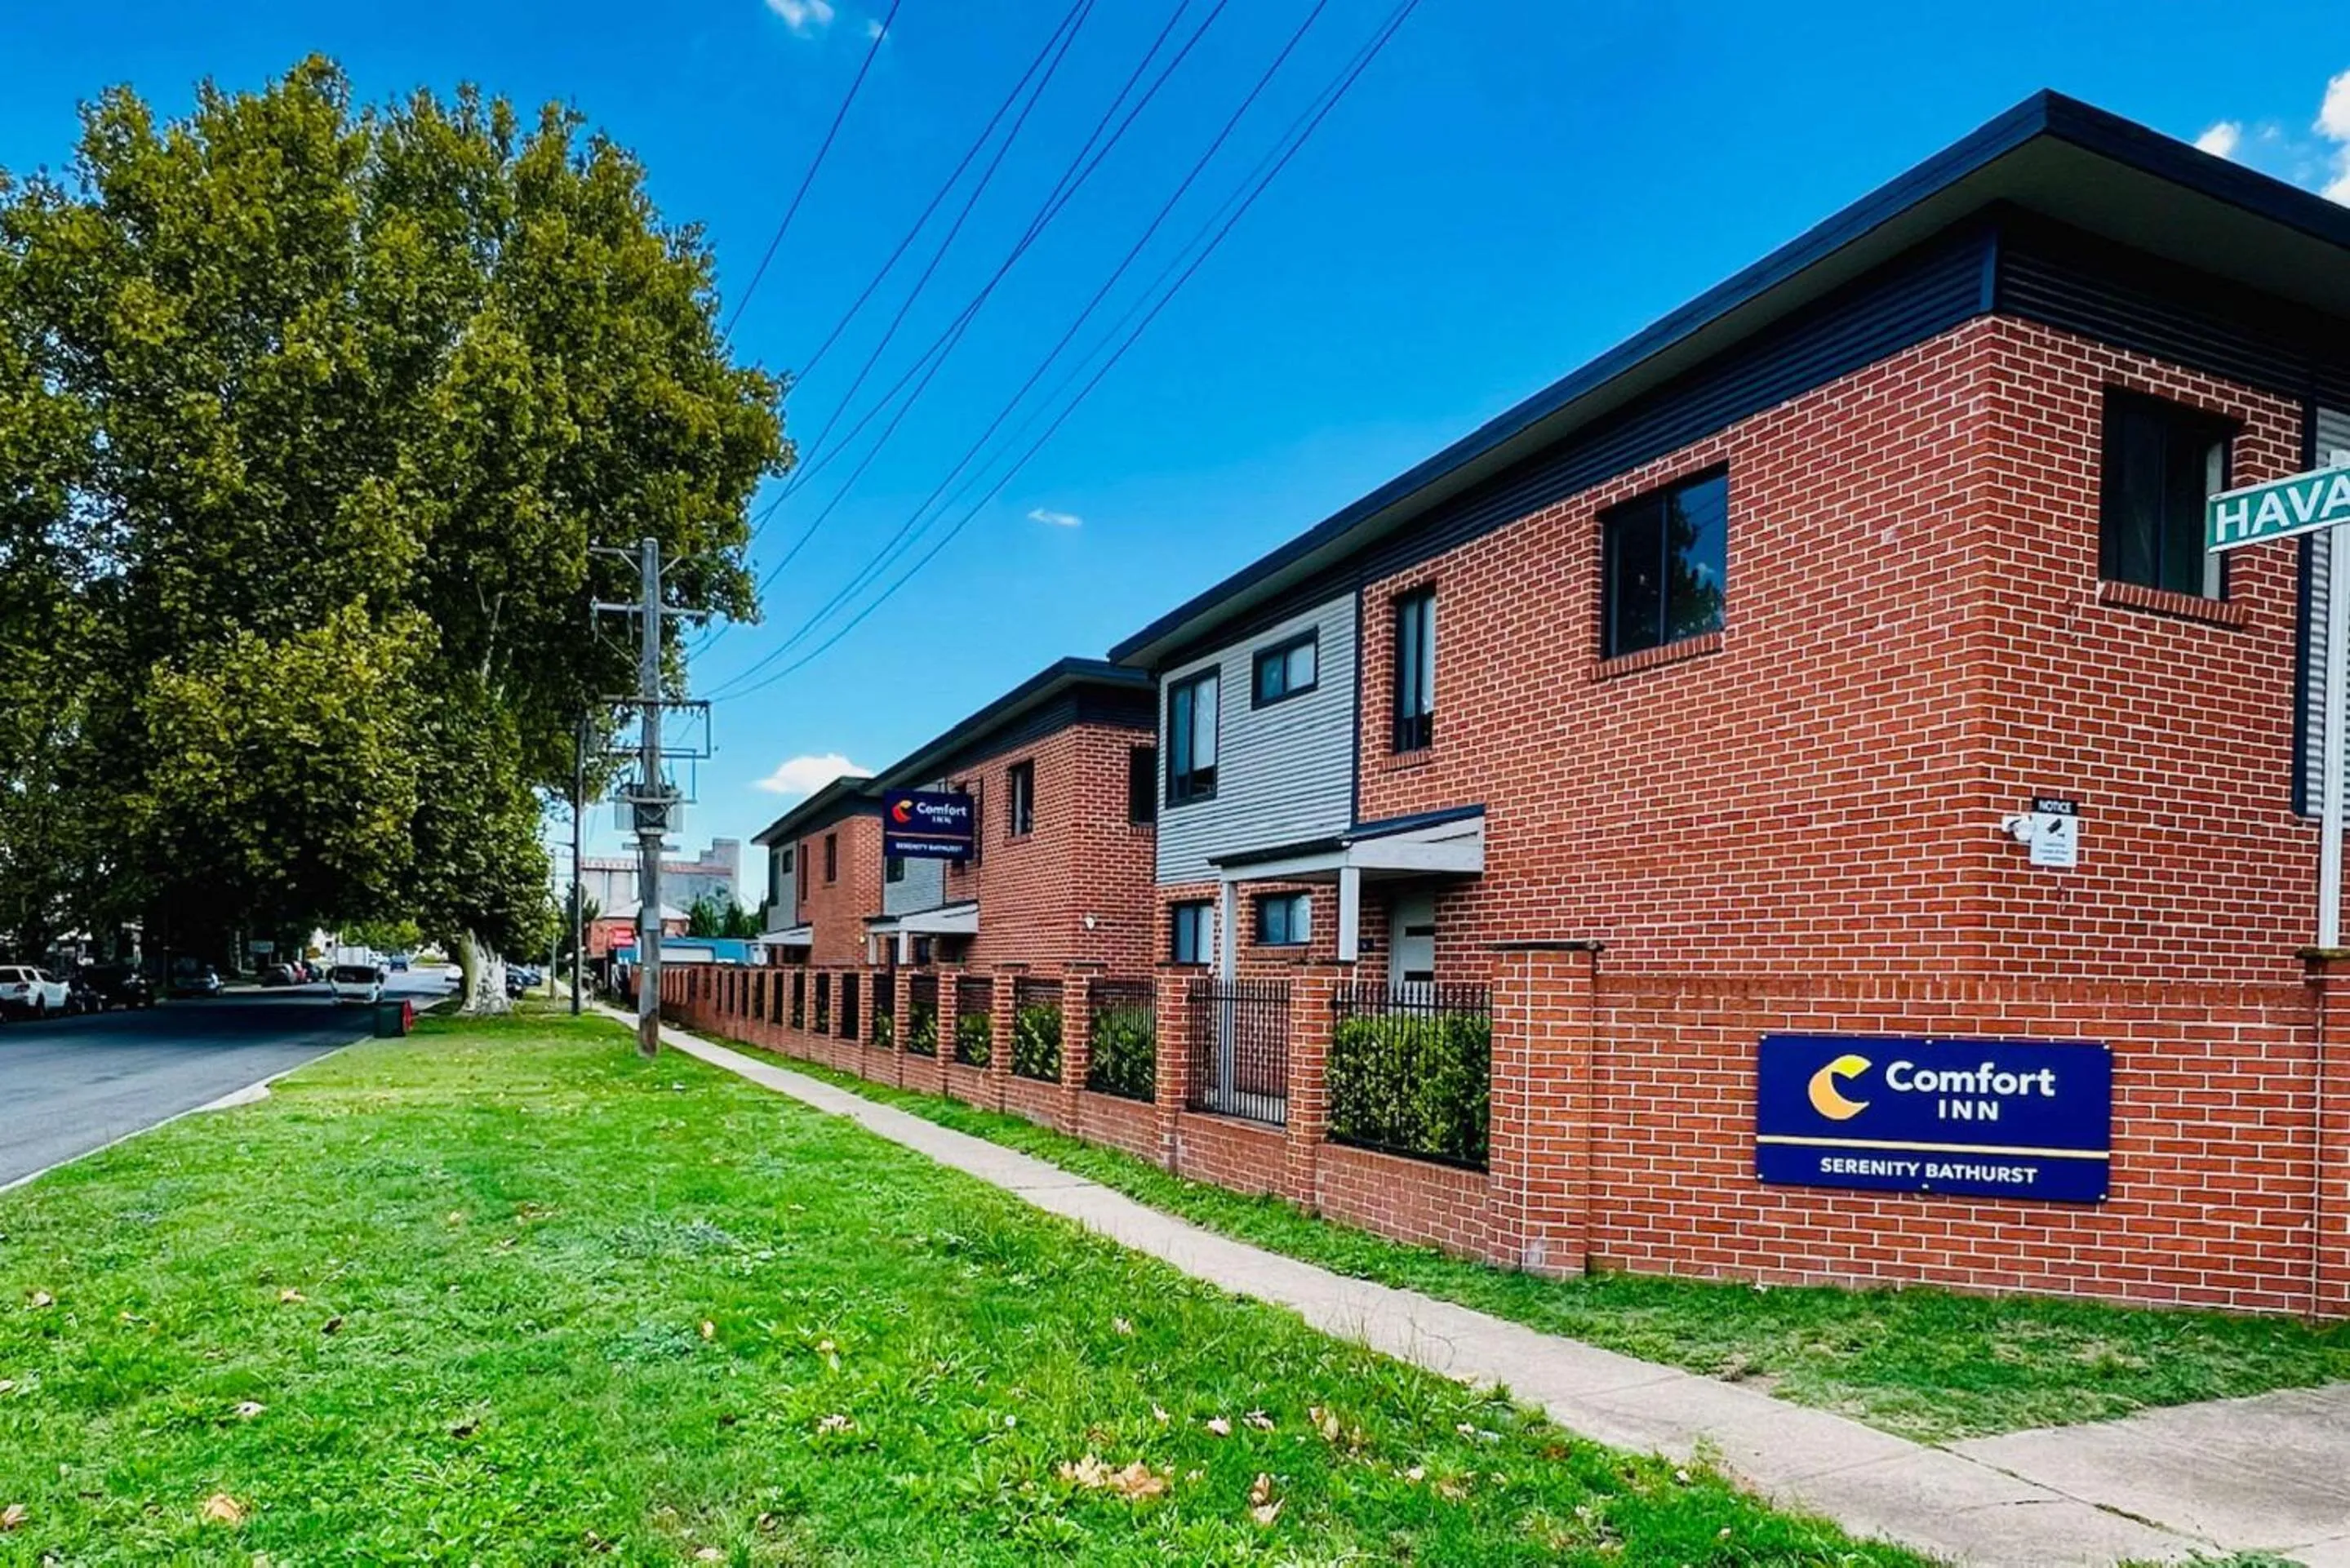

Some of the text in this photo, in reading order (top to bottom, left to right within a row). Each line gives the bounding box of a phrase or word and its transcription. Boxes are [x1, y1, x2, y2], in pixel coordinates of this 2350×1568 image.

[2215, 474, 2350, 543] HAVA
[917, 802, 966, 816] Comfort
[2038, 800, 2072, 813] NOTICE
[931, 816, 952, 824] INN
[1886, 1061, 2055, 1097] Comfort
[1939, 1099, 1999, 1122] INN
[1820, 1157, 2038, 1184] SERENITY BATHURST
